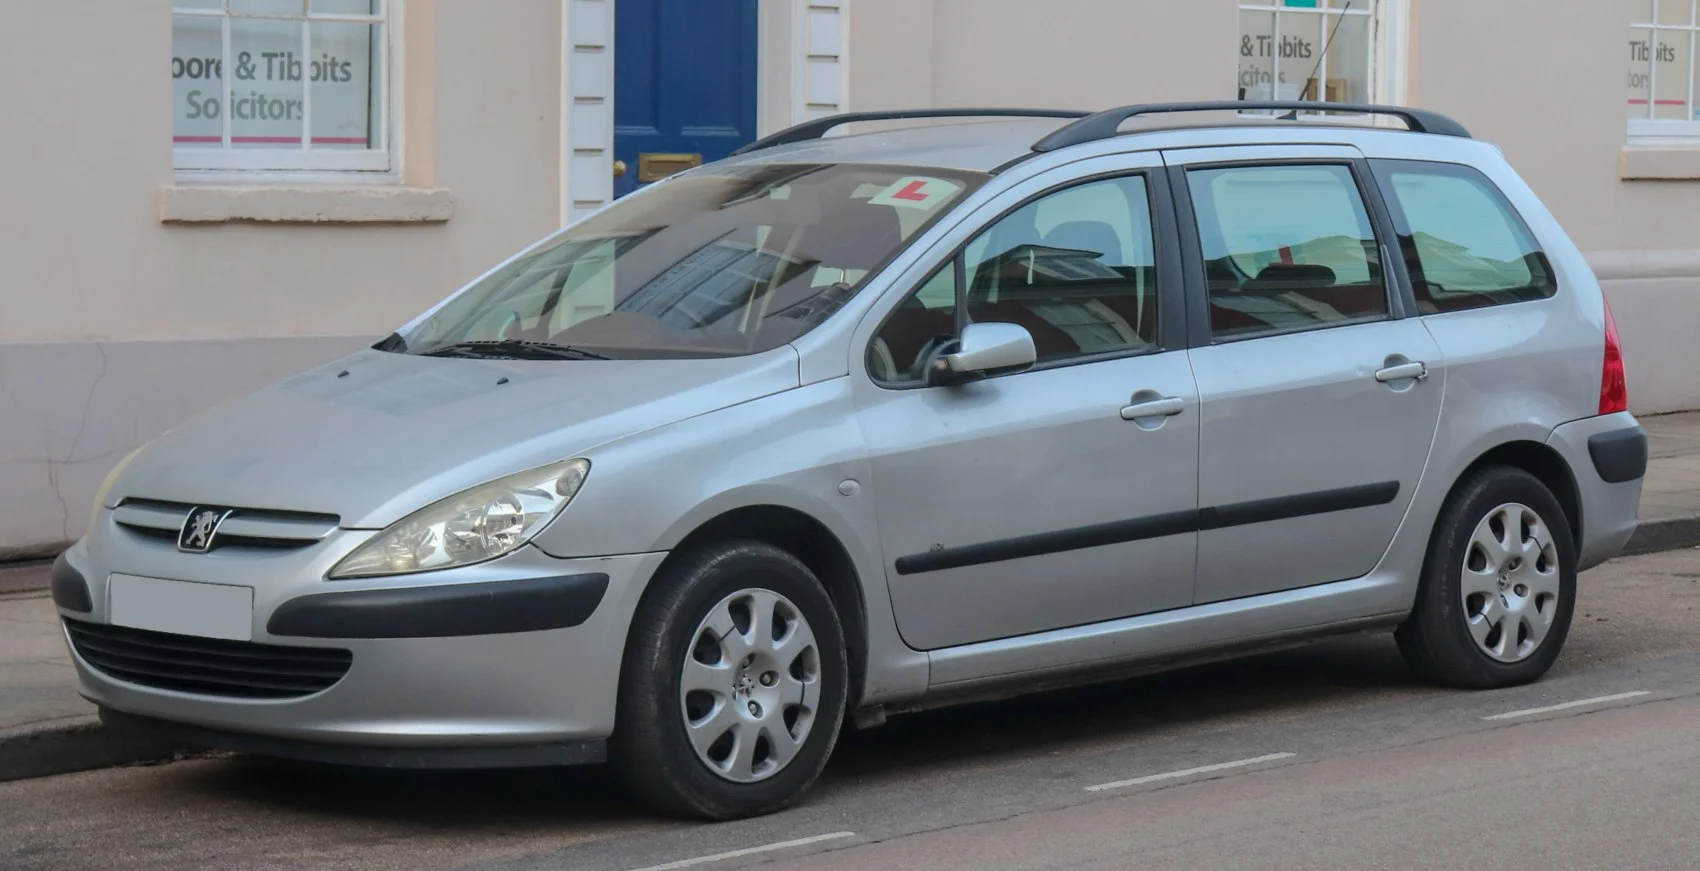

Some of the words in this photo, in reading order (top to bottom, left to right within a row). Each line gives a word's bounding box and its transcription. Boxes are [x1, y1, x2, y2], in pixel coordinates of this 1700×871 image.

[1241, 34, 1254, 57] &
[1256, 34, 1312, 59] Tibits
[1629, 40, 1676, 62] Tibits
[235, 50, 256, 80] &
[186, 89, 303, 120] Soicitors
[891, 180, 929, 201] L
